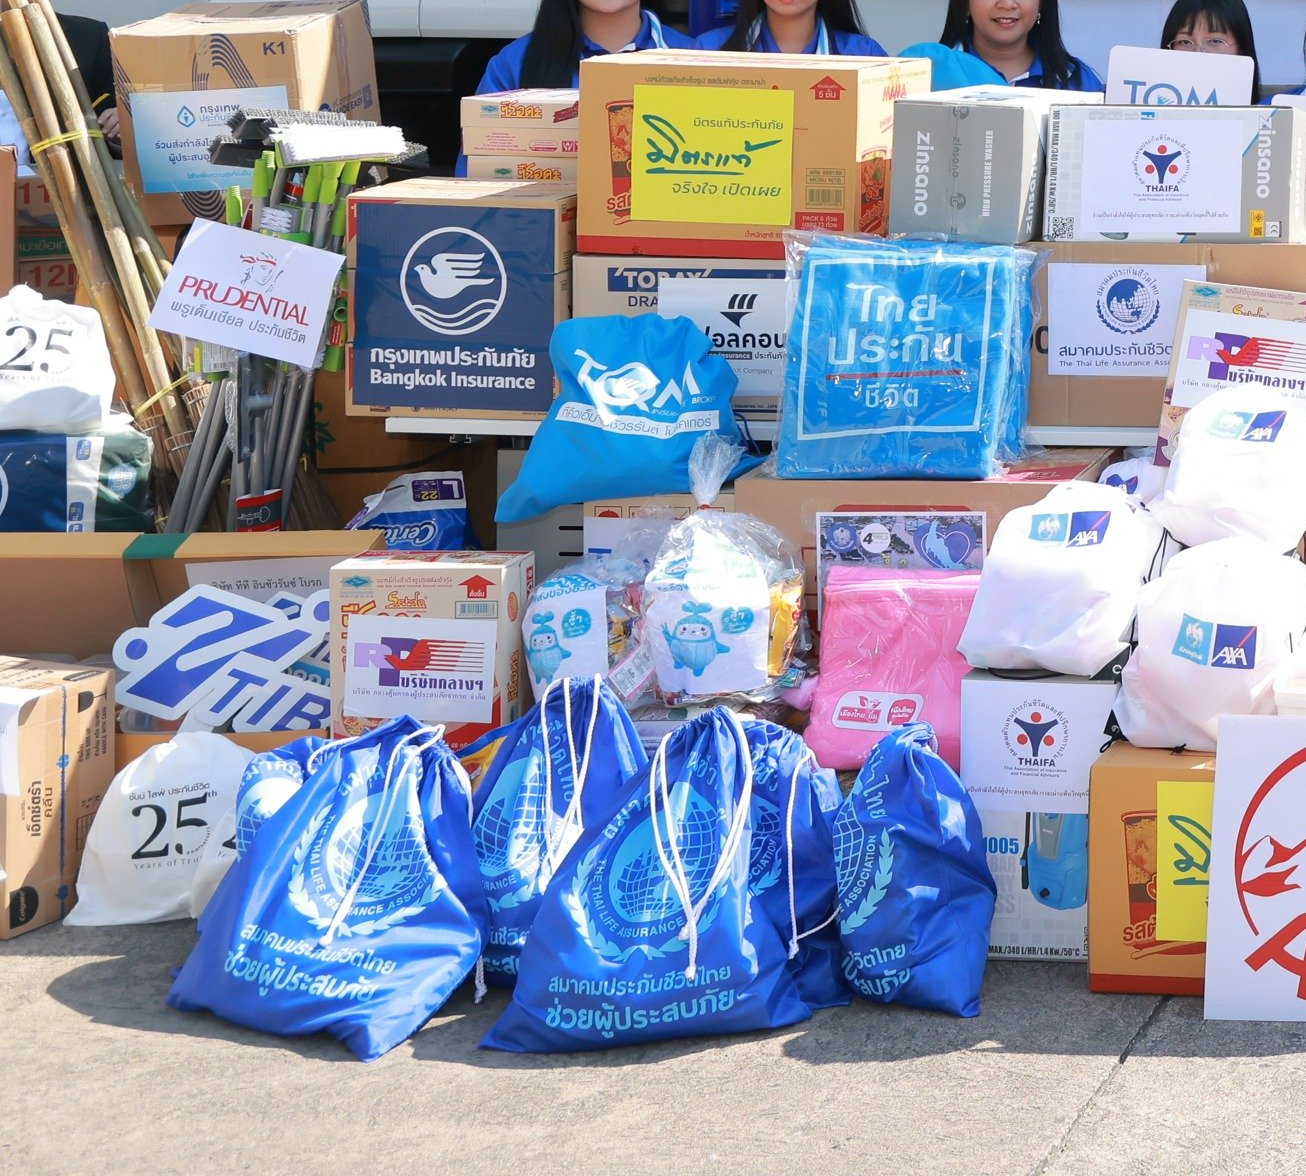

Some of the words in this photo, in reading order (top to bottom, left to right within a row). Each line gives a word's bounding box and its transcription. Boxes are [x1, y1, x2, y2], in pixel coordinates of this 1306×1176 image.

[263, 42, 286, 56] K1
[693, 117, 784, 130] มิตรแท้ประกันภัย
[984, 130, 994, 160] WASHER
[1256, 115, 1272, 198] zinsano
[914, 130, 934, 216] zinsano
[982, 161, 992, 198] PRESSURE
[672, 181, 719, 196] จริงใจ
[722, 182, 782, 198] เปิดเผย
[1025, 151, 1038, 234] zinsano
[1145, 184, 1180, 192] THAIFA
[981, 199, 991, 217] HIGH
[178, 275, 309, 327] PRUDENTIAL
[846, 282, 938, 323] ไทย
[170, 298, 244, 329] พรูเด็นเชียล
[248, 319, 306, 345] ประกันชีวิต
[827, 325, 964, 365] ประกัน
[369, 346, 536, 370] กรุงเทพประกันภัย
[1059, 360, 1074, 368] The
[1077, 360, 1092, 368] Thai
[1095, 360, 1109, 368] Life
[1112, 360, 1152, 368] Assurance
[369, 368, 448, 390] Bangkok
[450, 373, 536, 391] Insurance
[864, 382, 919, 409] ชีวิต
[1241, 425, 1273, 442] AXA
[1068, 528, 1099, 547] AXA
[1215, 646, 1250, 669] AXA
[399, 674, 485, 692] บริษัทกลางฯ
[1017, 757, 1057, 767] THAIFA
[43, 786, 53, 818] คลีน
[168, 781, 210, 799] ประกันชีวิต
[26, 780, 43, 837] เอ็กซ์ตร้า
[130, 794, 209, 861] 25
[133, 859, 163, 871] Years
[223, 942, 380, 1005] ช่วยผู้ประสบภัย
[544, 986, 736, 1039] ช่วยผู้ประสบภัย
